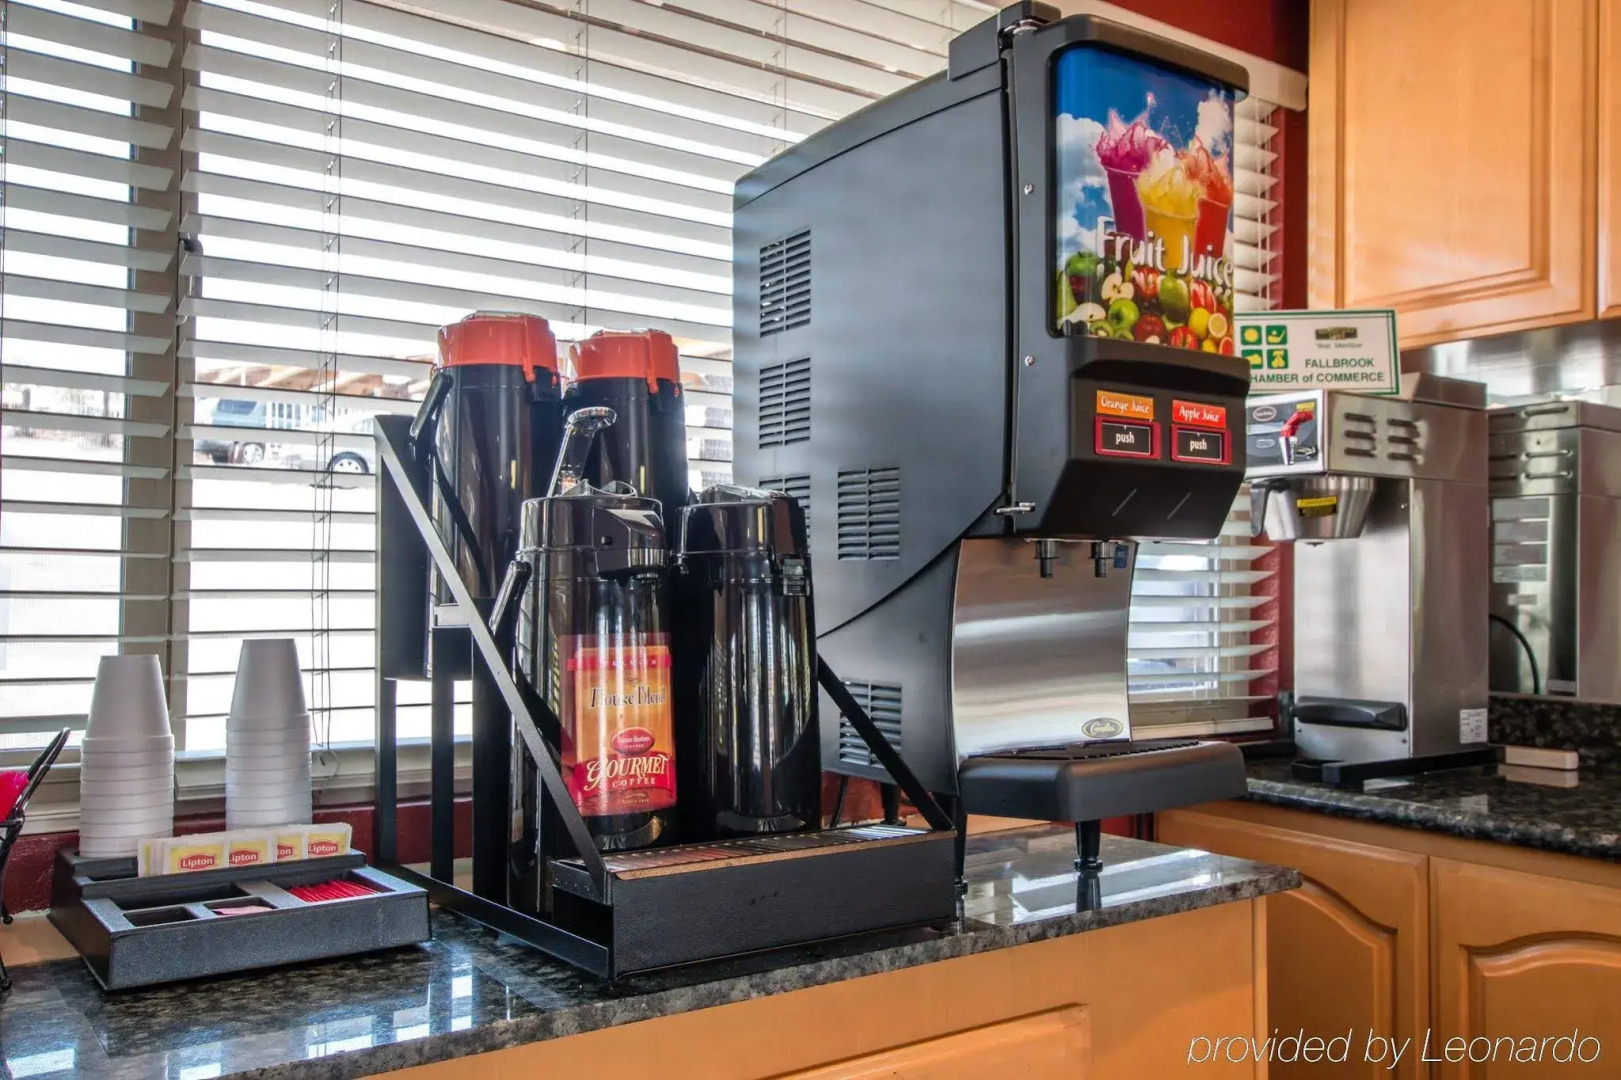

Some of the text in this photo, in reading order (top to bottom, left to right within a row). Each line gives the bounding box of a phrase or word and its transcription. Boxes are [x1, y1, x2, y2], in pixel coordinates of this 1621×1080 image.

[1096, 215, 1233, 288] Fruit Juice
[1304, 358, 1375, 368] FALLBROOK
[1250, 371, 1385, 383] HAMBER of COMMERCE
[1100, 396, 1150, 414] Orange Juice
[1179, 405, 1220, 422] Apple Juice
[1115, 431, 1135, 445] push
[1189, 438, 1208, 452] push
[583, 753, 670, 791] GOURMET
[612, 777, 656, 788] COFFEE
[308, 844, 337, 854] Lipton
[182, 858, 213, 868] Lipton
[229, 853, 257, 863] ipton
